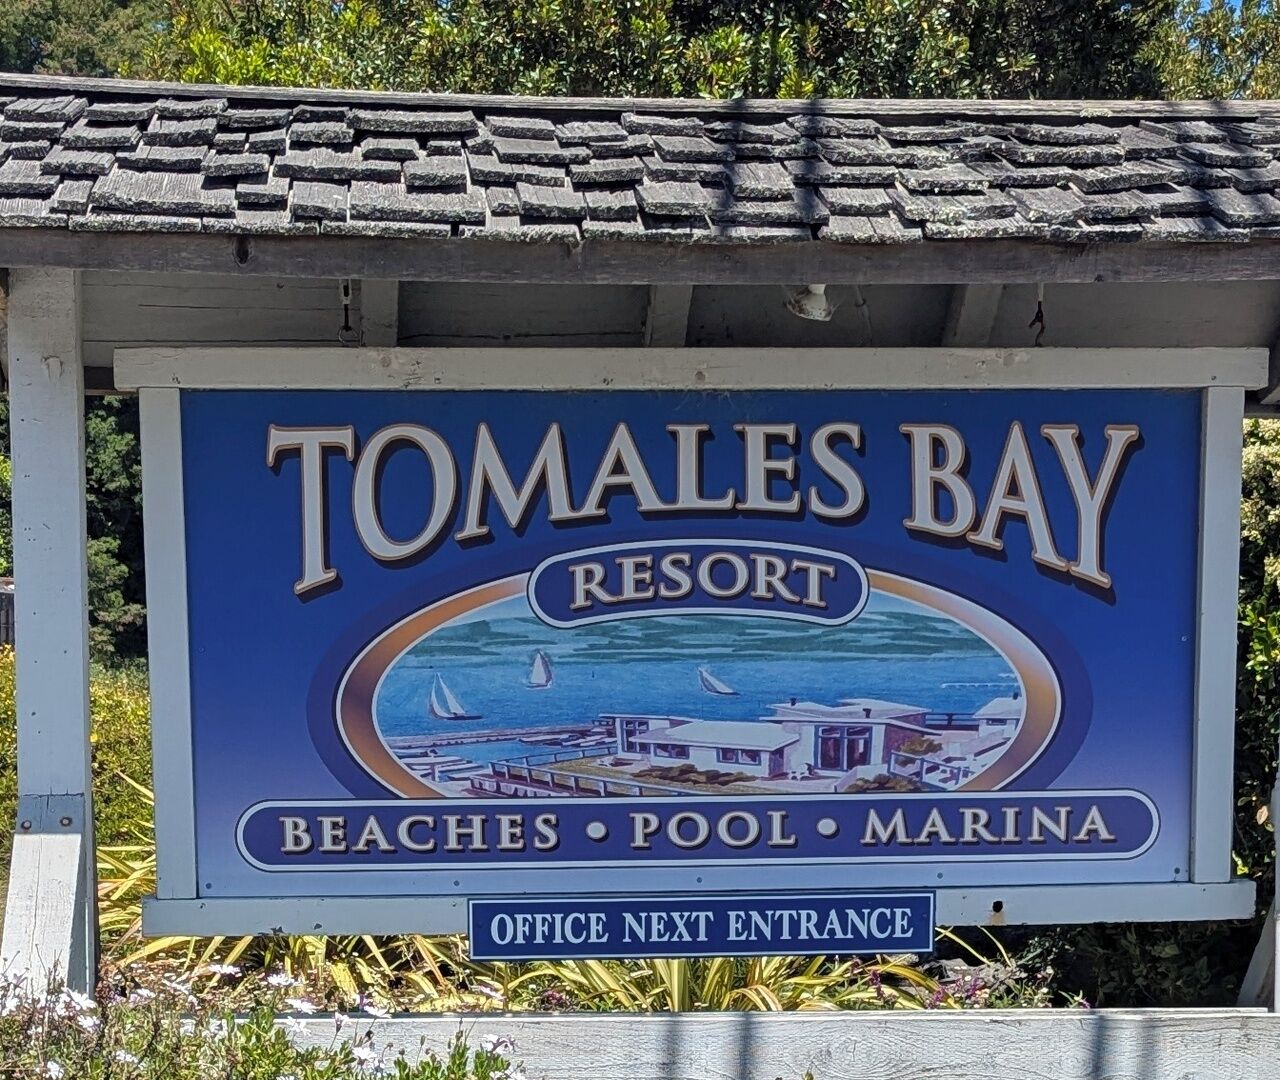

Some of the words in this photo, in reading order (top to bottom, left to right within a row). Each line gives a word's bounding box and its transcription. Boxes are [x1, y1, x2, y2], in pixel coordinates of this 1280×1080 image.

[267, 422, 866, 595] TOMALES
[899, 422, 1139, 590] BAY
[570, 552, 837, 610] RESORT
[279, 814, 561, 854] BEACHES
[629, 811, 797, 850] POOL
[860, 805, 1116, 846] MARINA
[489, 912, 609, 945] OFFICE
[622, 910, 715, 943] NEXT
[726, 906, 913, 941] ENTRANCE
